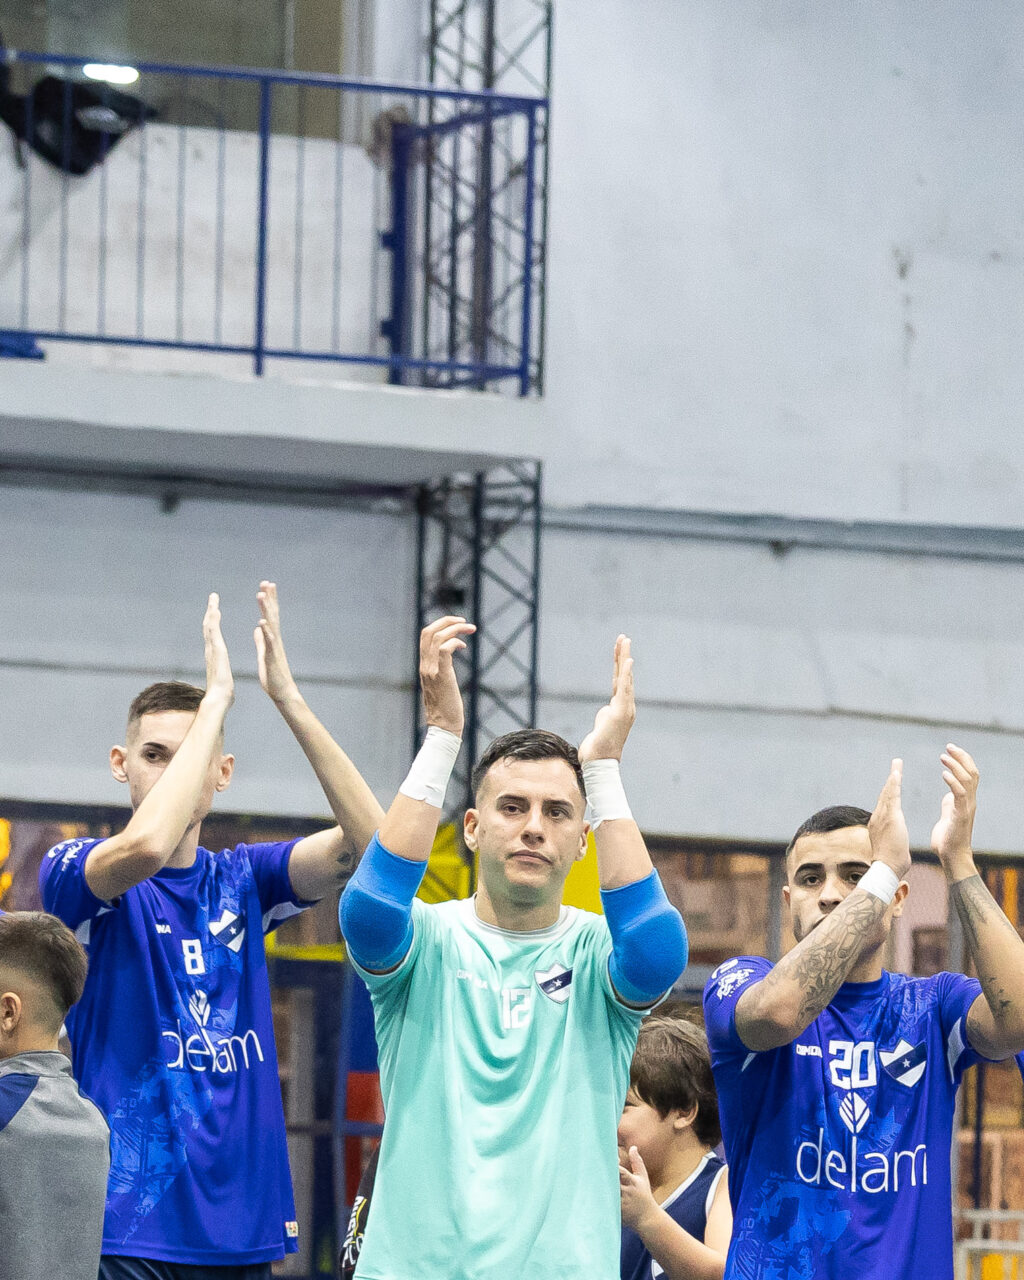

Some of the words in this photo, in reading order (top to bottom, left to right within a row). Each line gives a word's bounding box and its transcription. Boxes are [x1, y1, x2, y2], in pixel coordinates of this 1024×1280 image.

[181, 939, 206, 975] 8
[501, 988, 531, 1029] 12
[162, 1018, 264, 1073] delam
[829, 1040, 877, 1090] 20
[796, 1127, 927, 1193] delam
